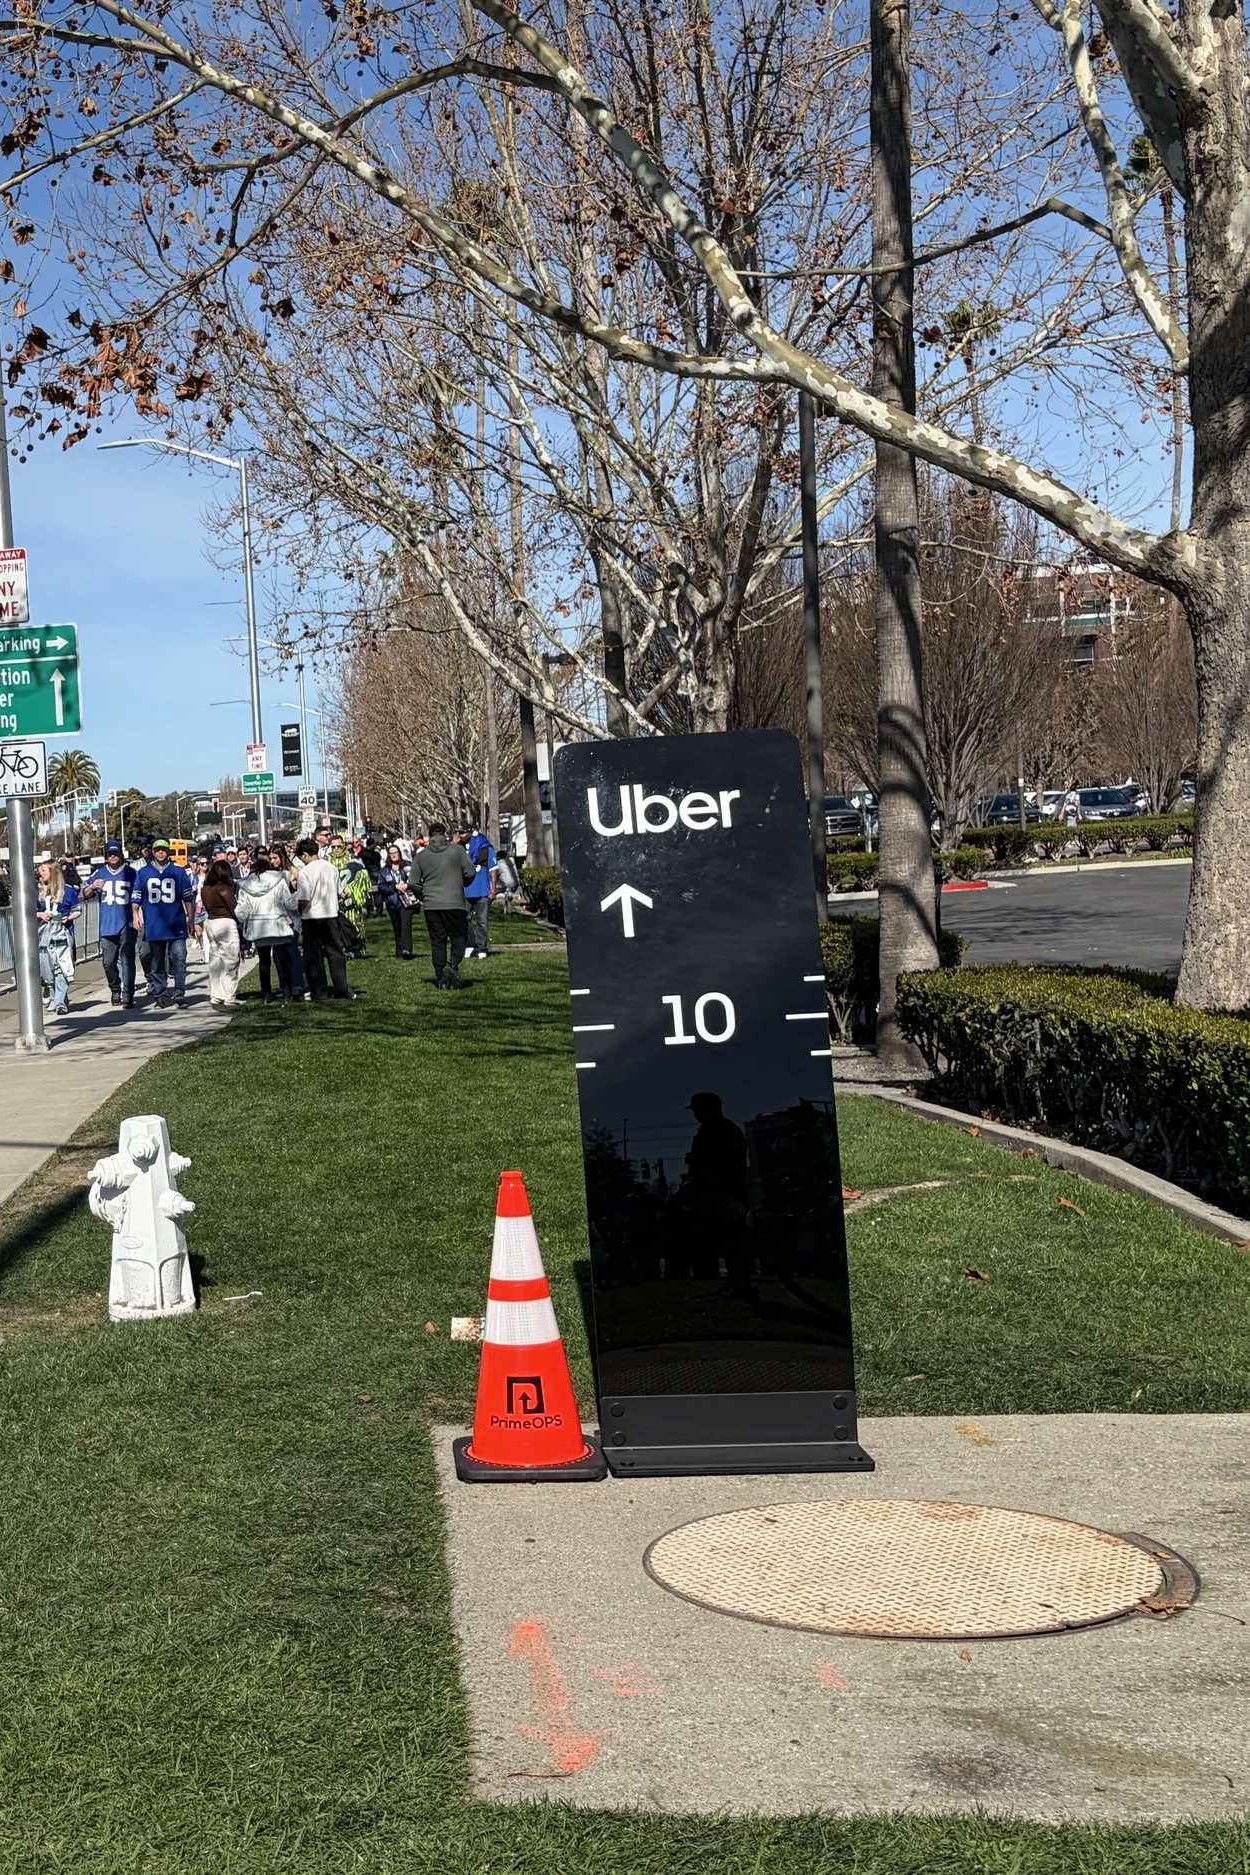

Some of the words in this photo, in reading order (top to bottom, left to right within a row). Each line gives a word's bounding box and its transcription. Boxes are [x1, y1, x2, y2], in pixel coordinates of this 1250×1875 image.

[14, 781, 41, 793] LANE
[300, 796, 316, 805] 40
[587, 784, 741, 837] Uber
[101, 880, 131, 905] 45
[147, 877, 176, 904] 69
[662, 991, 736, 1046] 10
[490, 1415, 563, 1430] PrimeOPS
